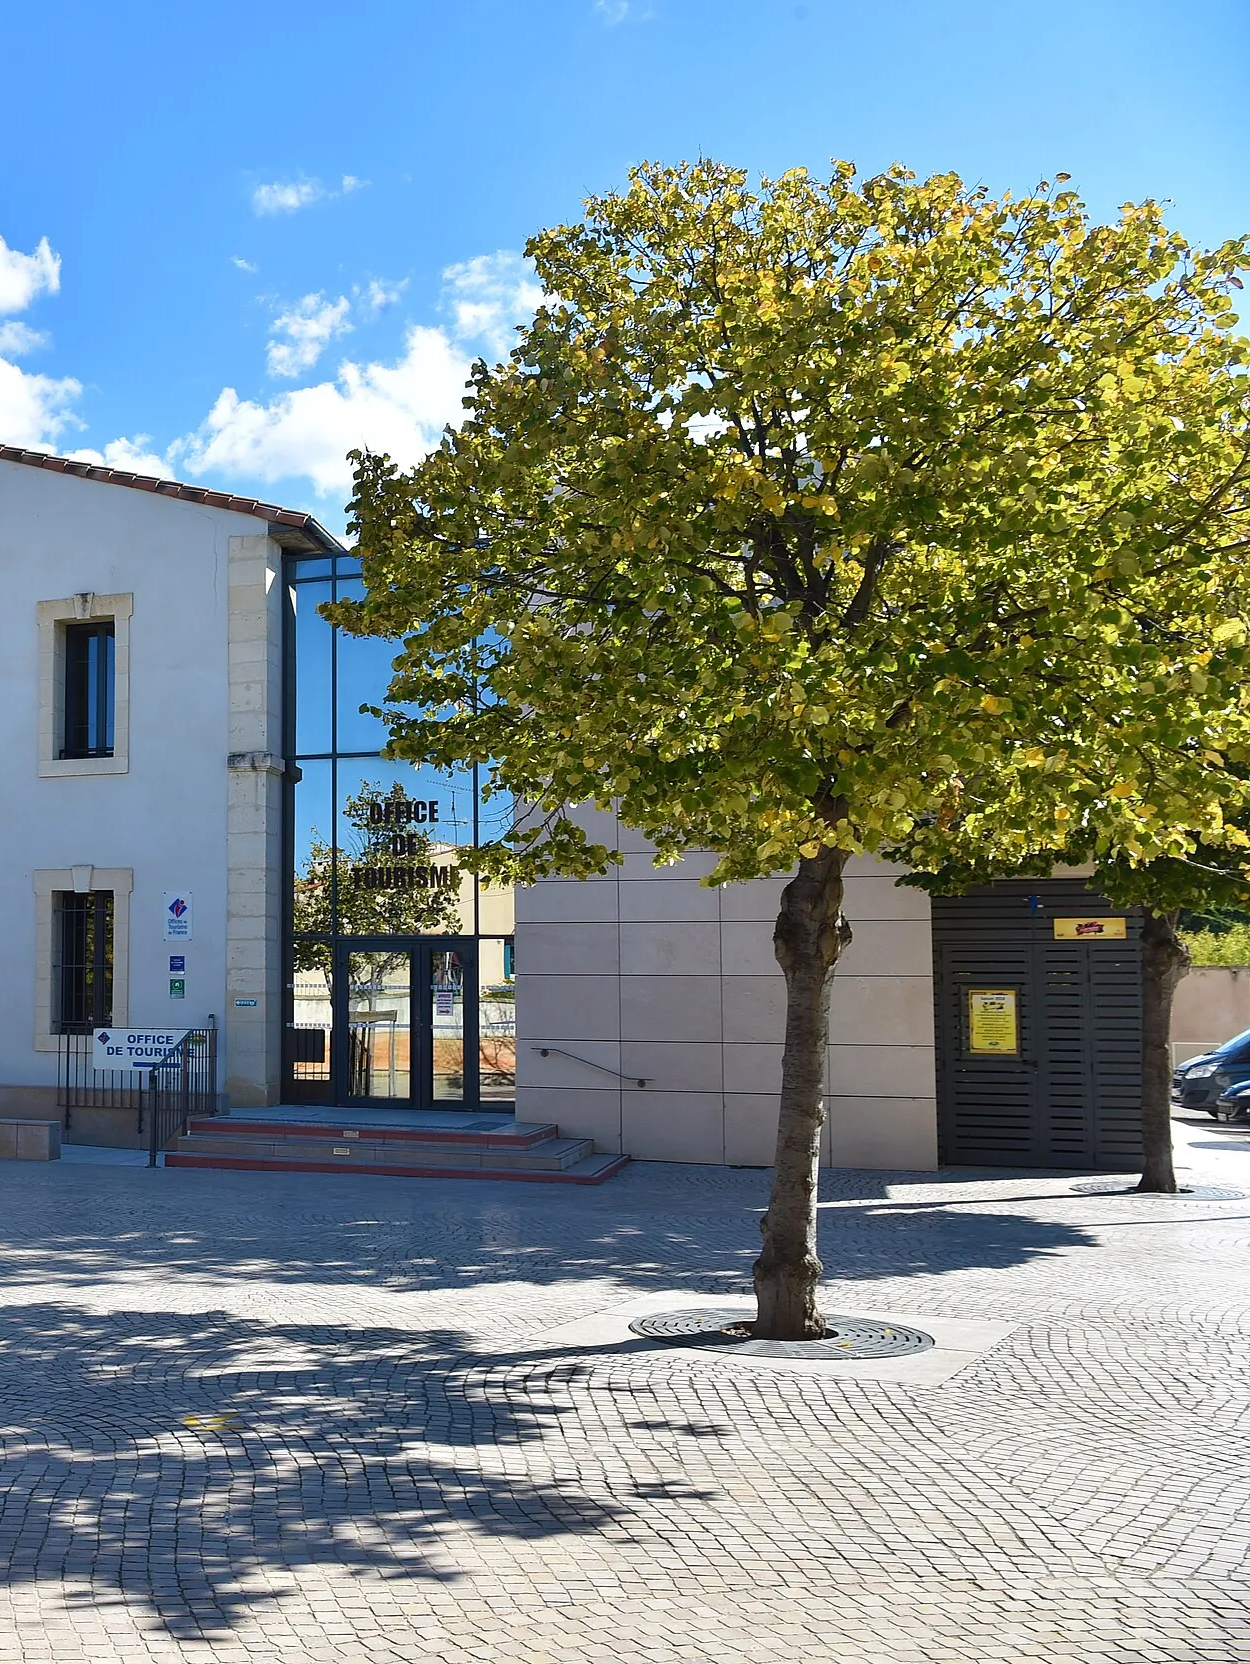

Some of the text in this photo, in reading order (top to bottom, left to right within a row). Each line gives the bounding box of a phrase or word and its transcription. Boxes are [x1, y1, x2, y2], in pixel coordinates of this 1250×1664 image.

[370, 801, 439, 824] OFFICE
[393, 833, 418, 856] DE
[127, 1034, 174, 1045] OFFICE
[107, 1046, 123, 1056] DE
